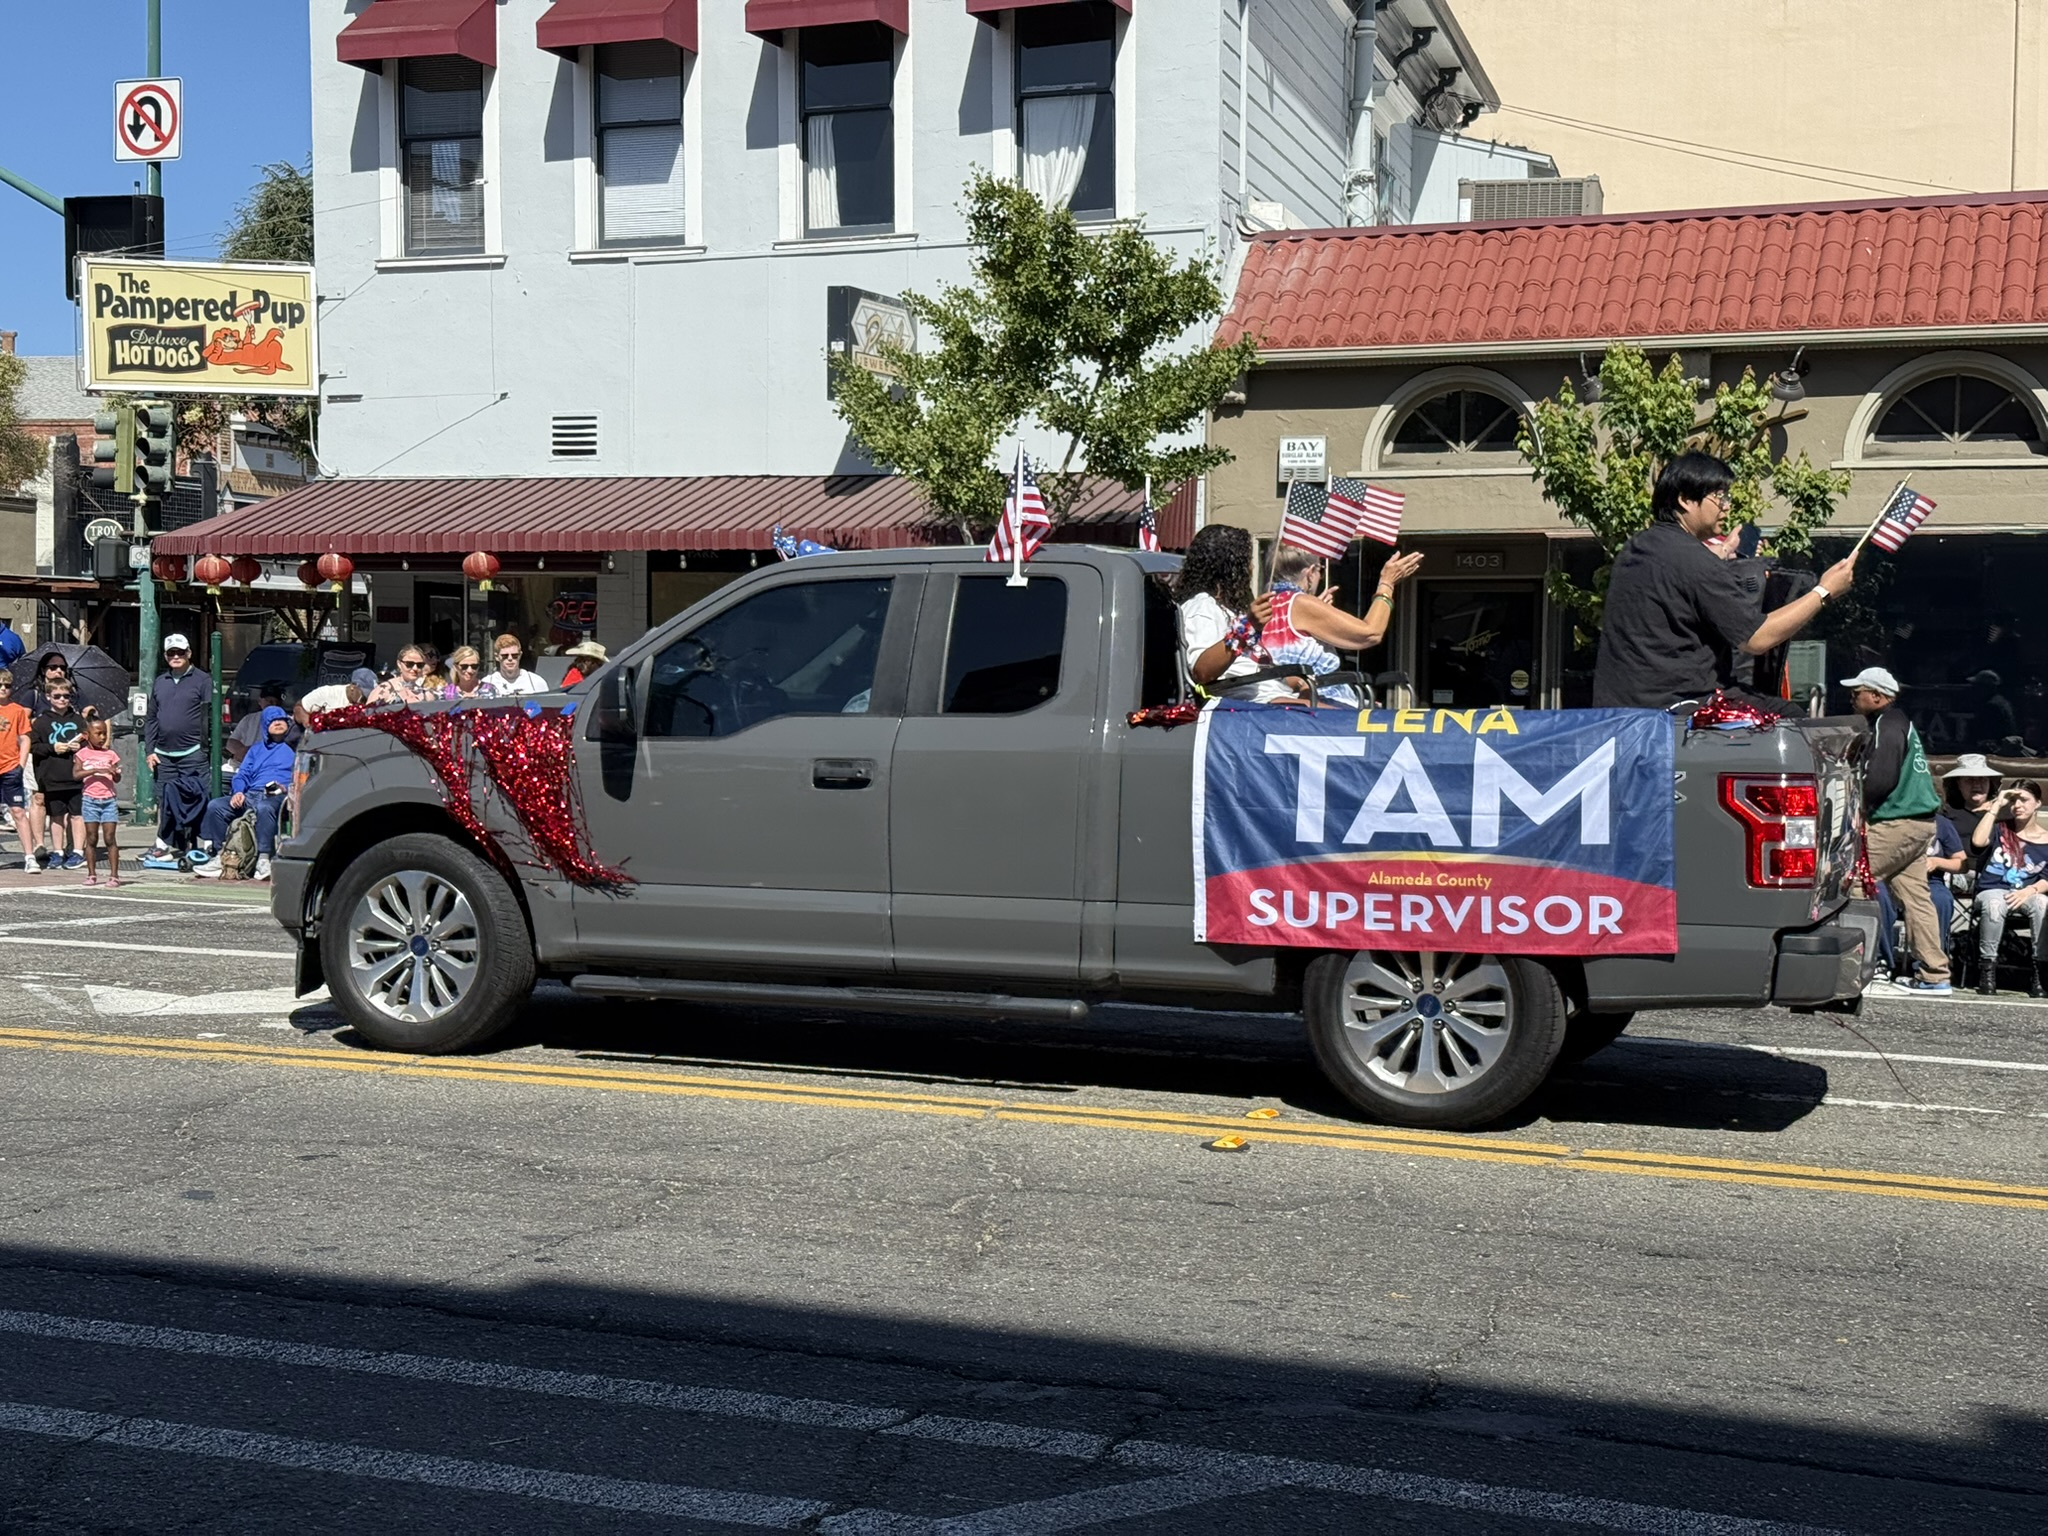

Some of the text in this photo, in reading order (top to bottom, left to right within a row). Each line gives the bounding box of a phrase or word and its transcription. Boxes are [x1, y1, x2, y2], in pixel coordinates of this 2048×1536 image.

[117, 272, 150, 294] The
[94, 283, 306, 329] Pampered Pup
[130, 328, 190, 346] Deluxe
[115, 339, 201, 368] HOT DOGS
[1287, 441, 1319, 451] BAY
[89, 525, 117, 536] TROY
[1456, 555, 1500, 568] 1403
[1356, 708, 1520, 735] LENA
[1264, 734, 1615, 847] TAM
[1368, 871, 1492, 890] Alameda County
[1246, 888, 1623, 935] SUPERVISOR
